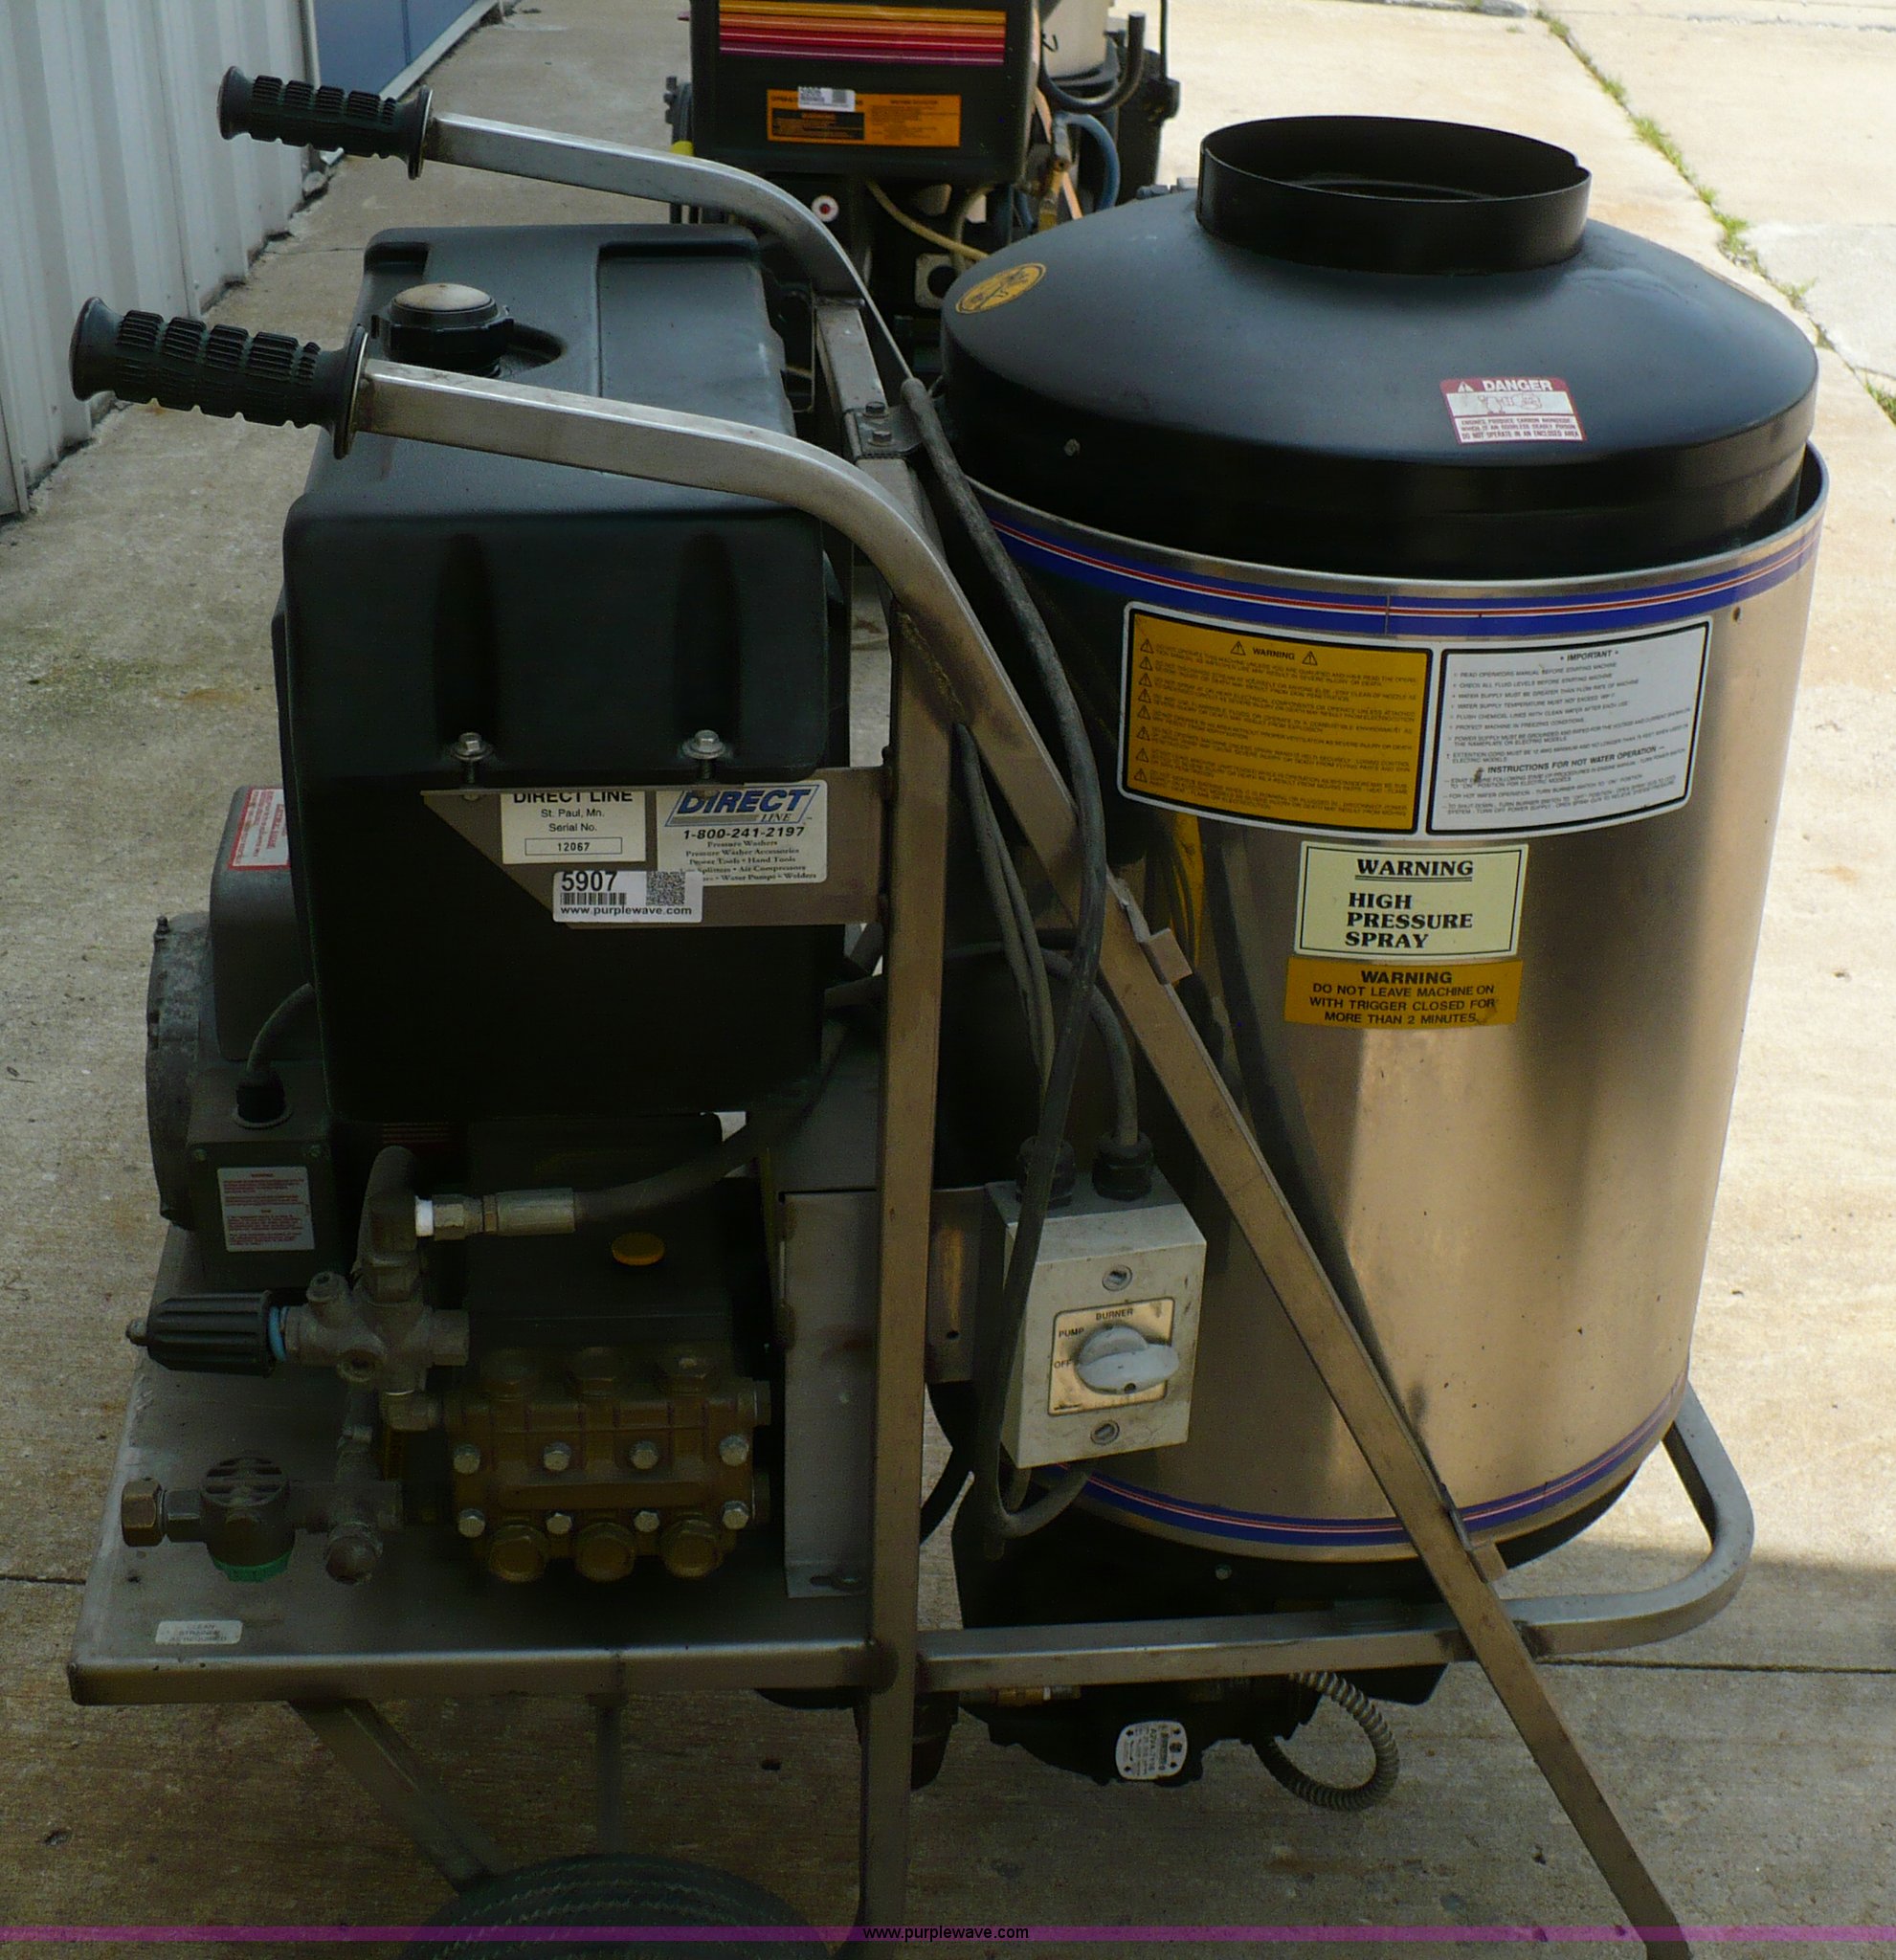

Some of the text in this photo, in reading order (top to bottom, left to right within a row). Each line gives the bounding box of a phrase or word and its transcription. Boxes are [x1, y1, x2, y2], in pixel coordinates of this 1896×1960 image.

[1482, 380, 1552, 391] DANGER
[1253, 647, 1295, 660] WARNING
[1567, 651, 1613, 661] IMPORTANT
[1487, 762, 1550, 774] INSTRUCTIONS
[1551, 760, 1570, 769] FOR
[1571, 758, 1587, 768] HOT
[1590, 754, 1616, 764] WATER
[1617, 746, 1657, 760] OPERATION
[590, 791, 634, 802] LINE
[677, 790, 812, 814] DIRECT
[541, 809, 605, 819] St. Paul, Mn.
[760, 813, 794, 823] LINE
[548, 823, 597, 833] Serial No.
[683, 827, 805, 840] 1-800-241-2197
[557, 842, 591, 852] 12067
[1357, 858, 1474, 877] WARNING
[561, 871, 618, 892] 5907
[1348, 892, 1413, 910] HIGH
[560, 905, 692, 917] www.purplewave.com
[1347, 911, 1474, 930] PRESSURE
[1345, 931, 1429, 949] SPRAY
[1361, 970, 1453, 985] WARNING
[1313, 983, 1495, 997] DO NOT LEAVE MACHINE ON
[1309, 996, 1496, 1012] WITH TRIGGER CLOSED FOR
[1325, 1011, 1362, 1024] MORE
[1367, 1013, 1403, 1025] THAN
[1408, 1015, 1416, 1025] 2
[1095, 1307, 1134, 1322] BURNER
[1059, 1326, 1085, 1339] PUMP
[1054, 1359, 1072, 1370] OFF
